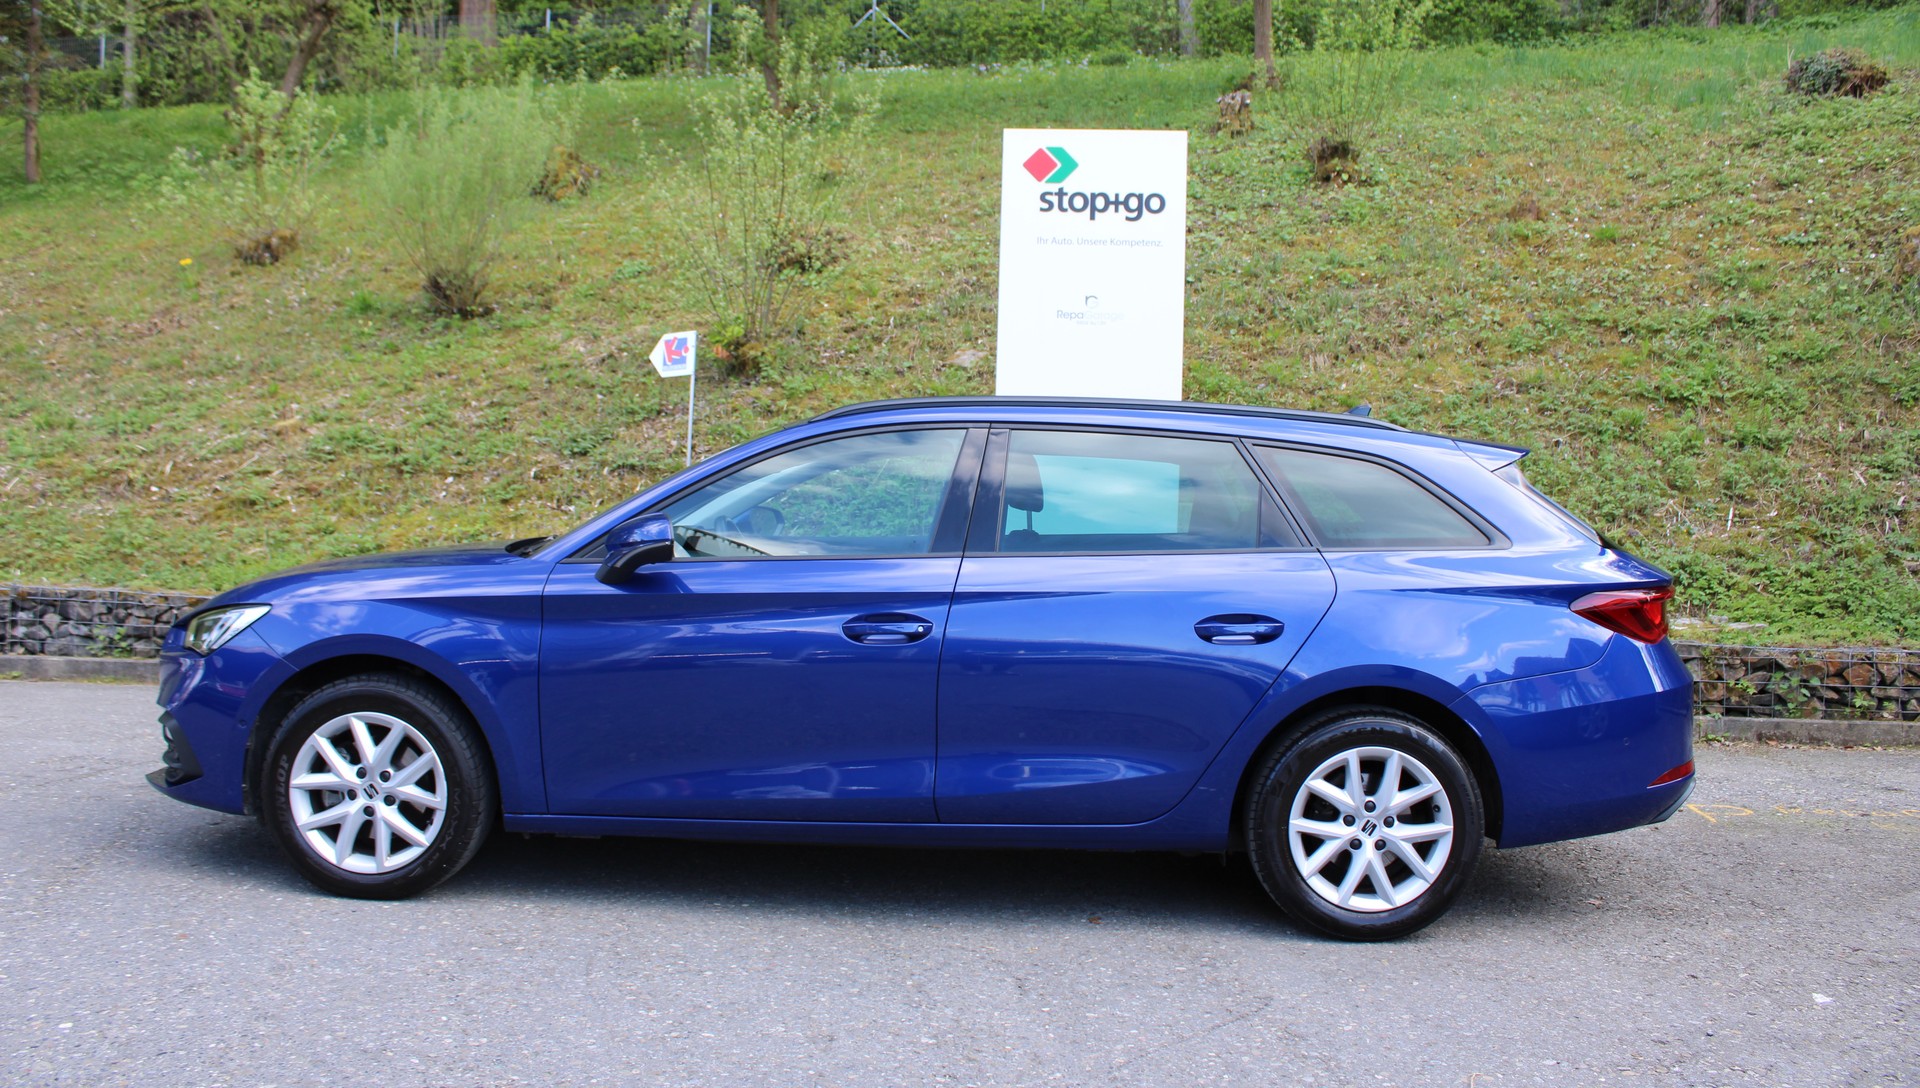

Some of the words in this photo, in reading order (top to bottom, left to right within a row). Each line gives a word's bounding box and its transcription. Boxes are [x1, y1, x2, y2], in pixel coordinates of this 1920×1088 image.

[1039, 187, 1166, 222] stop+go
[1036, 236, 1048, 245] Ihr
[1051, 236, 1074, 245] Auto.
[1077, 236, 1107, 246] Unsere
[1110, 237, 1163, 248] Kompetenz.
